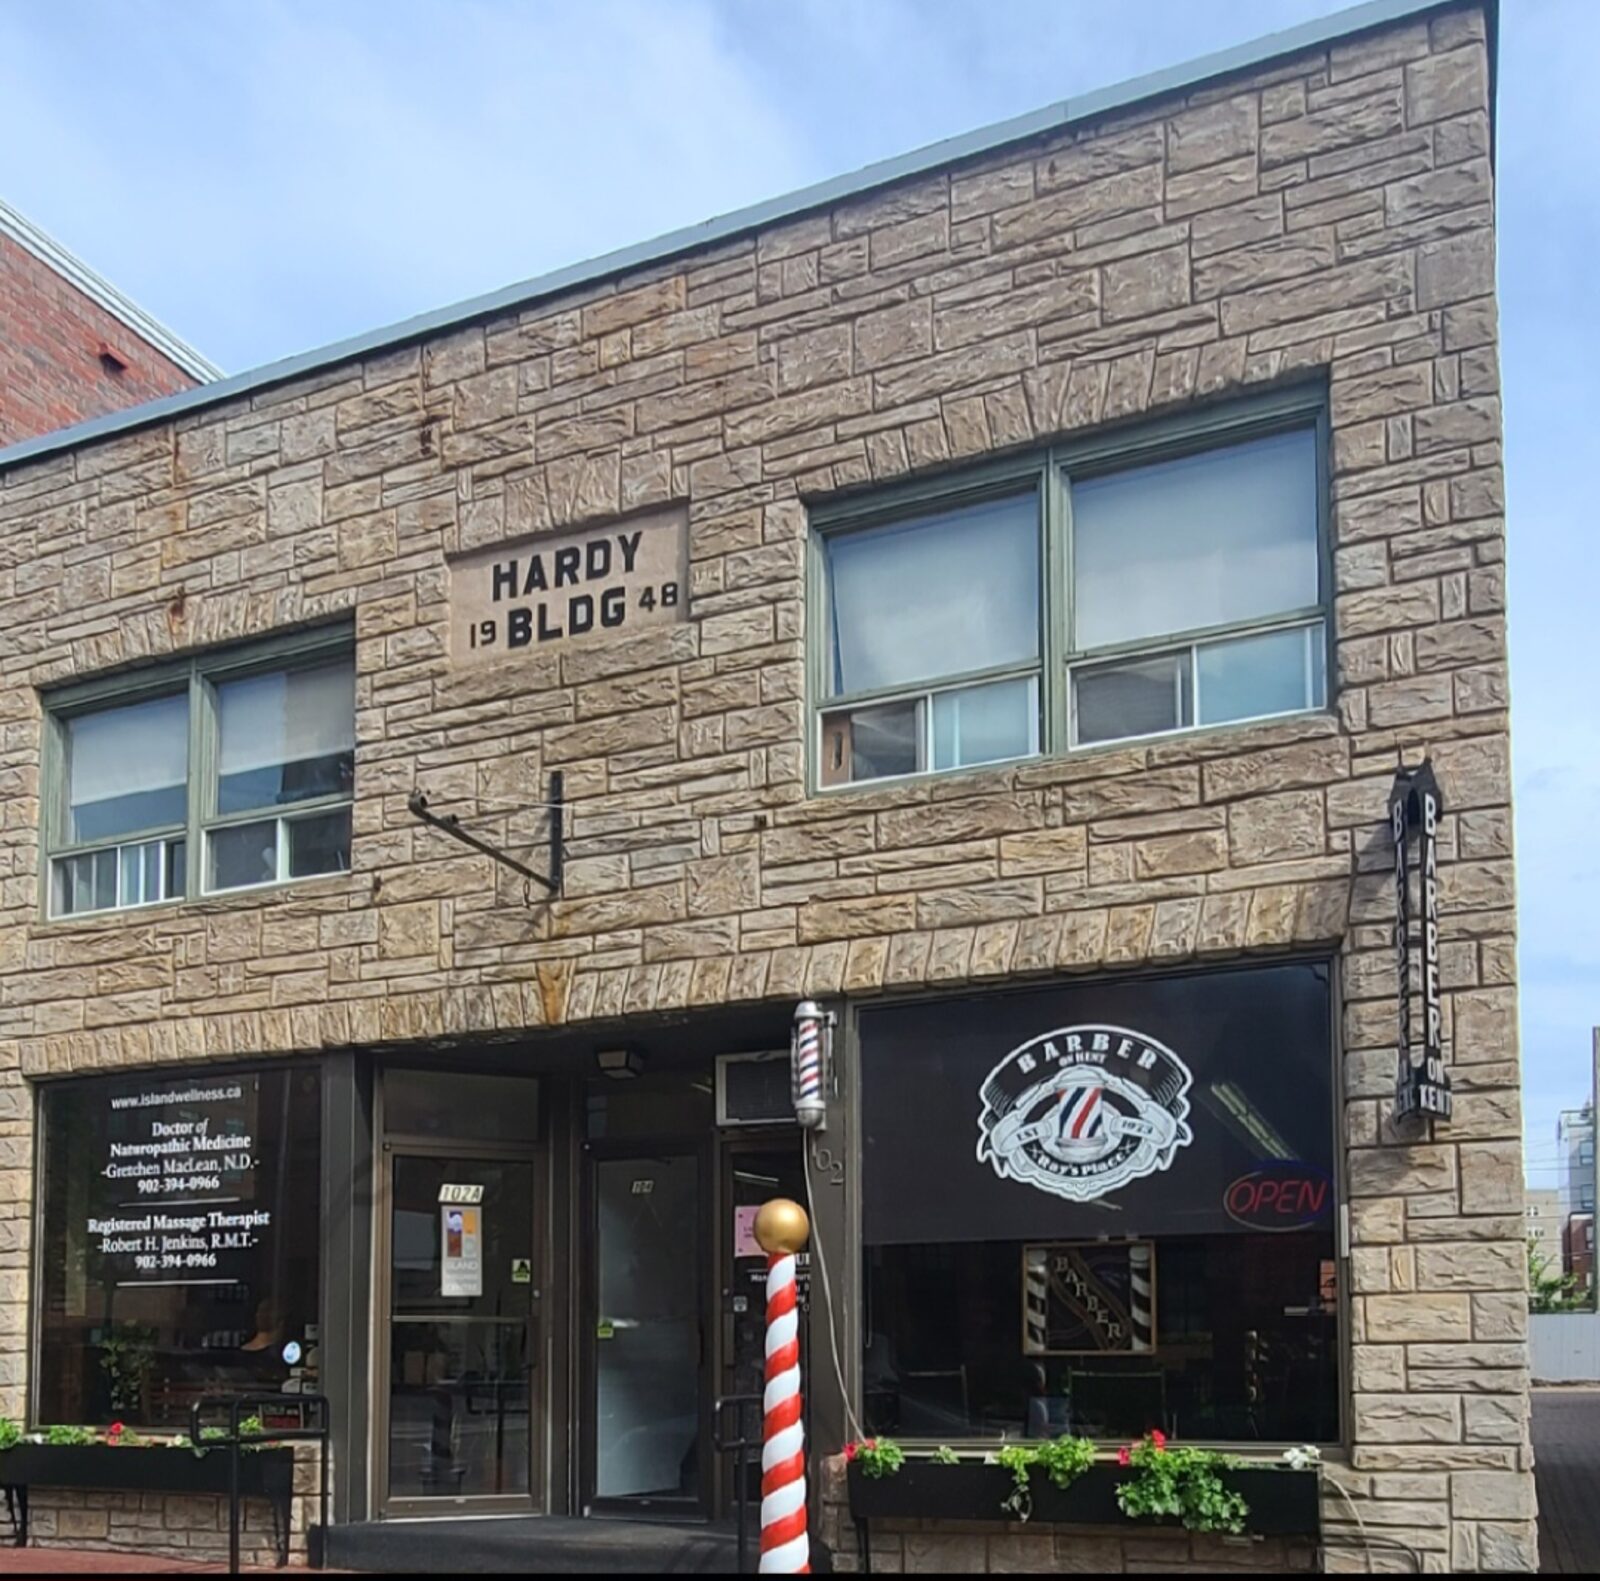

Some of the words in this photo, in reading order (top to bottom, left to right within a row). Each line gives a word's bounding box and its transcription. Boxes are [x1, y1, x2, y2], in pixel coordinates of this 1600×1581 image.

[492, 531, 643, 602] HARDY
[470, 620, 496, 649] 19
[507, 586, 626, 649] BLDG
[638, 582, 679, 613] 48
[1424, 793, 1441, 1049] BARBER
[1016, 1033, 1158, 1074] BARBER
[1427, 1056, 1444, 1084] ON
[111, 1086, 242, 1110] www.islandwellness.ca
[1419, 1084, 1451, 1115] KENT
[152, 1122, 193, 1137] Doctor
[195, 1118, 210, 1137] of
[110, 1139, 191, 1158] Naturopathic
[193, 1134, 251, 1151] Medicine
[163, 1158, 222, 1175] MacLean,
[137, 1175, 220, 1194] 902-394-0966
[442, 1186, 480, 1200] 102A
[1230, 1180, 1327, 1213] OPEN
[87, 1216, 151, 1236] Registered
[153, 1215, 206, 1232] Massage
[207, 1210, 270, 1230] Therapist
[144, 1236, 159, 1251] H.
[161, 1234, 209, 1253] Jenkins,
[135, 1253, 216, 1269] 902-394-0966
[1055, 1256, 1122, 1338] BARBER
